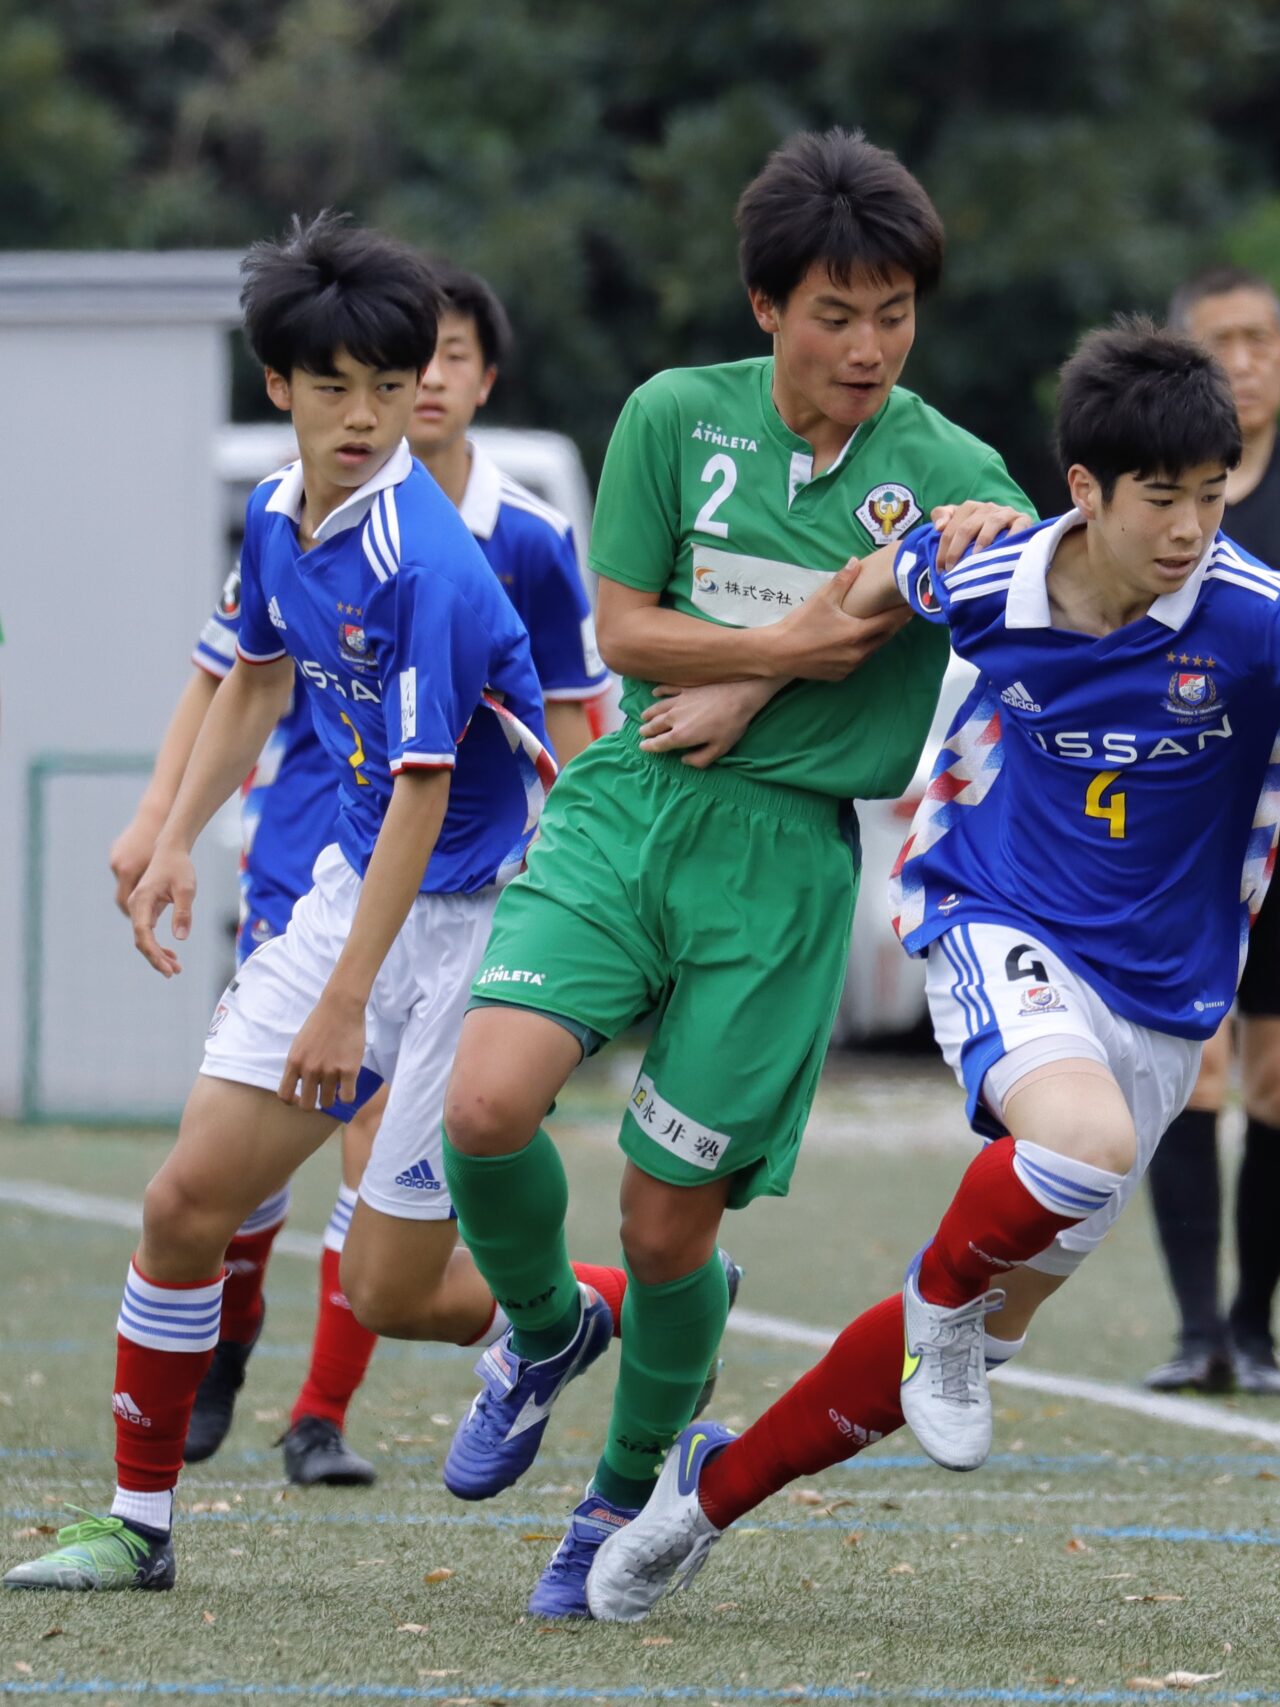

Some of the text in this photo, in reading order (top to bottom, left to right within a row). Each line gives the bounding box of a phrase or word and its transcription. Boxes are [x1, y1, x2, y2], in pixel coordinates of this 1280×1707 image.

[691, 427, 758, 452] ATHLETA
[694, 453, 737, 539] 2
[725, 581, 805, 606] 株式会社
[294, 656, 383, 704] ISSA
[1001, 694, 1041, 713] adidas
[1029, 714, 1233, 764] ISSAN
[1085, 770, 1126, 839] 4
[477, 970, 543, 986] ATHLETA
[395, 1175, 441, 1190] adidas
[112, 1402, 152, 1428] idas
[828, 1408, 868, 1446] adid
